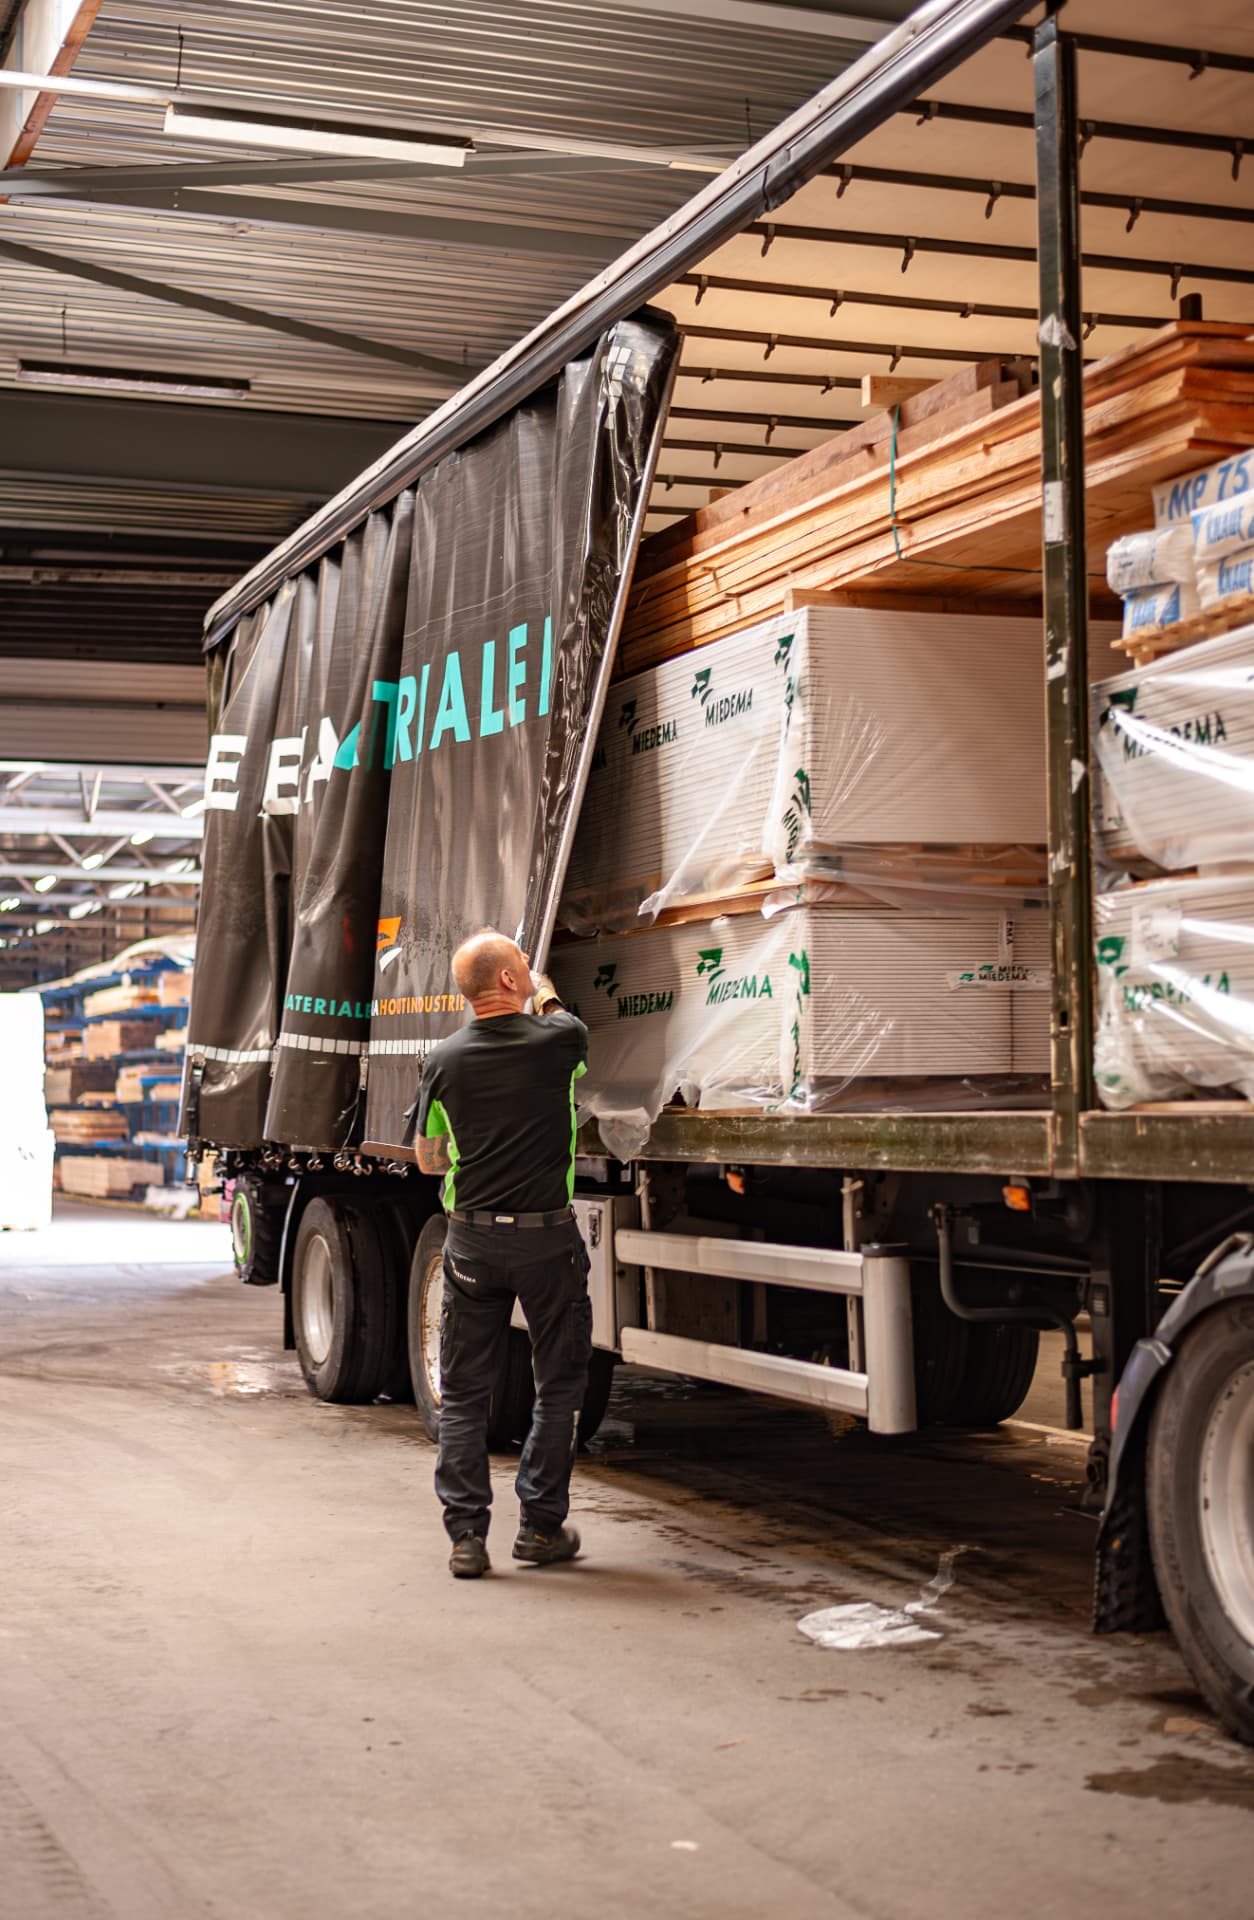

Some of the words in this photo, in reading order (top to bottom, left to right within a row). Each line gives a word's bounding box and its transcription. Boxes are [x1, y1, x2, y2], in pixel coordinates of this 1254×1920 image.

[1217, 455, 1251, 502] 75
[705, 688, 753, 728] MIEDEMA
[632, 720, 677, 755] MIEDEMA
[617, 991, 673, 1019] MIEDEMA
[706, 975, 772, 1005] MIEDEMA
